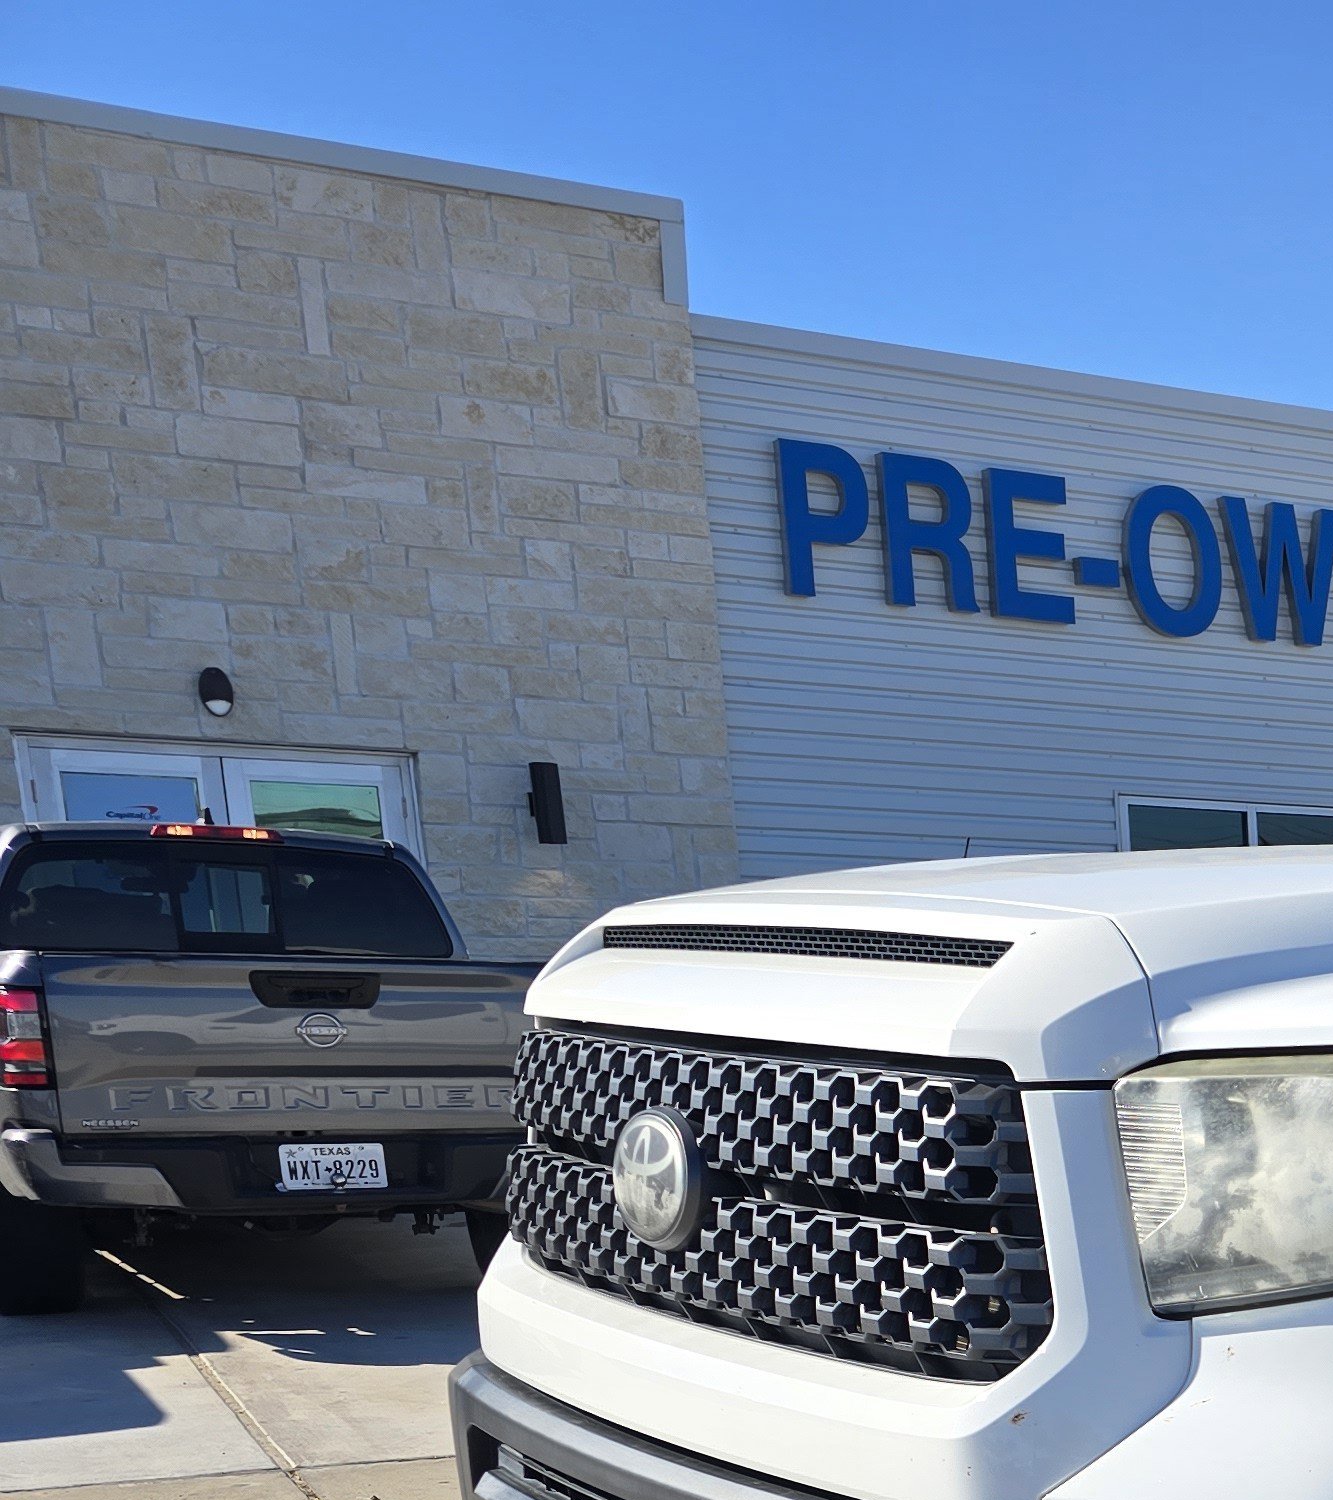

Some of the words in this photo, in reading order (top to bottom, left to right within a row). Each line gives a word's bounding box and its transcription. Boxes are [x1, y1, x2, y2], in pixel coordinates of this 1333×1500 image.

[296, 1026, 347, 1035] NISSAN
[312, 1147, 351, 1156] TEXAS
[287, 1160, 321, 1180] WXT
